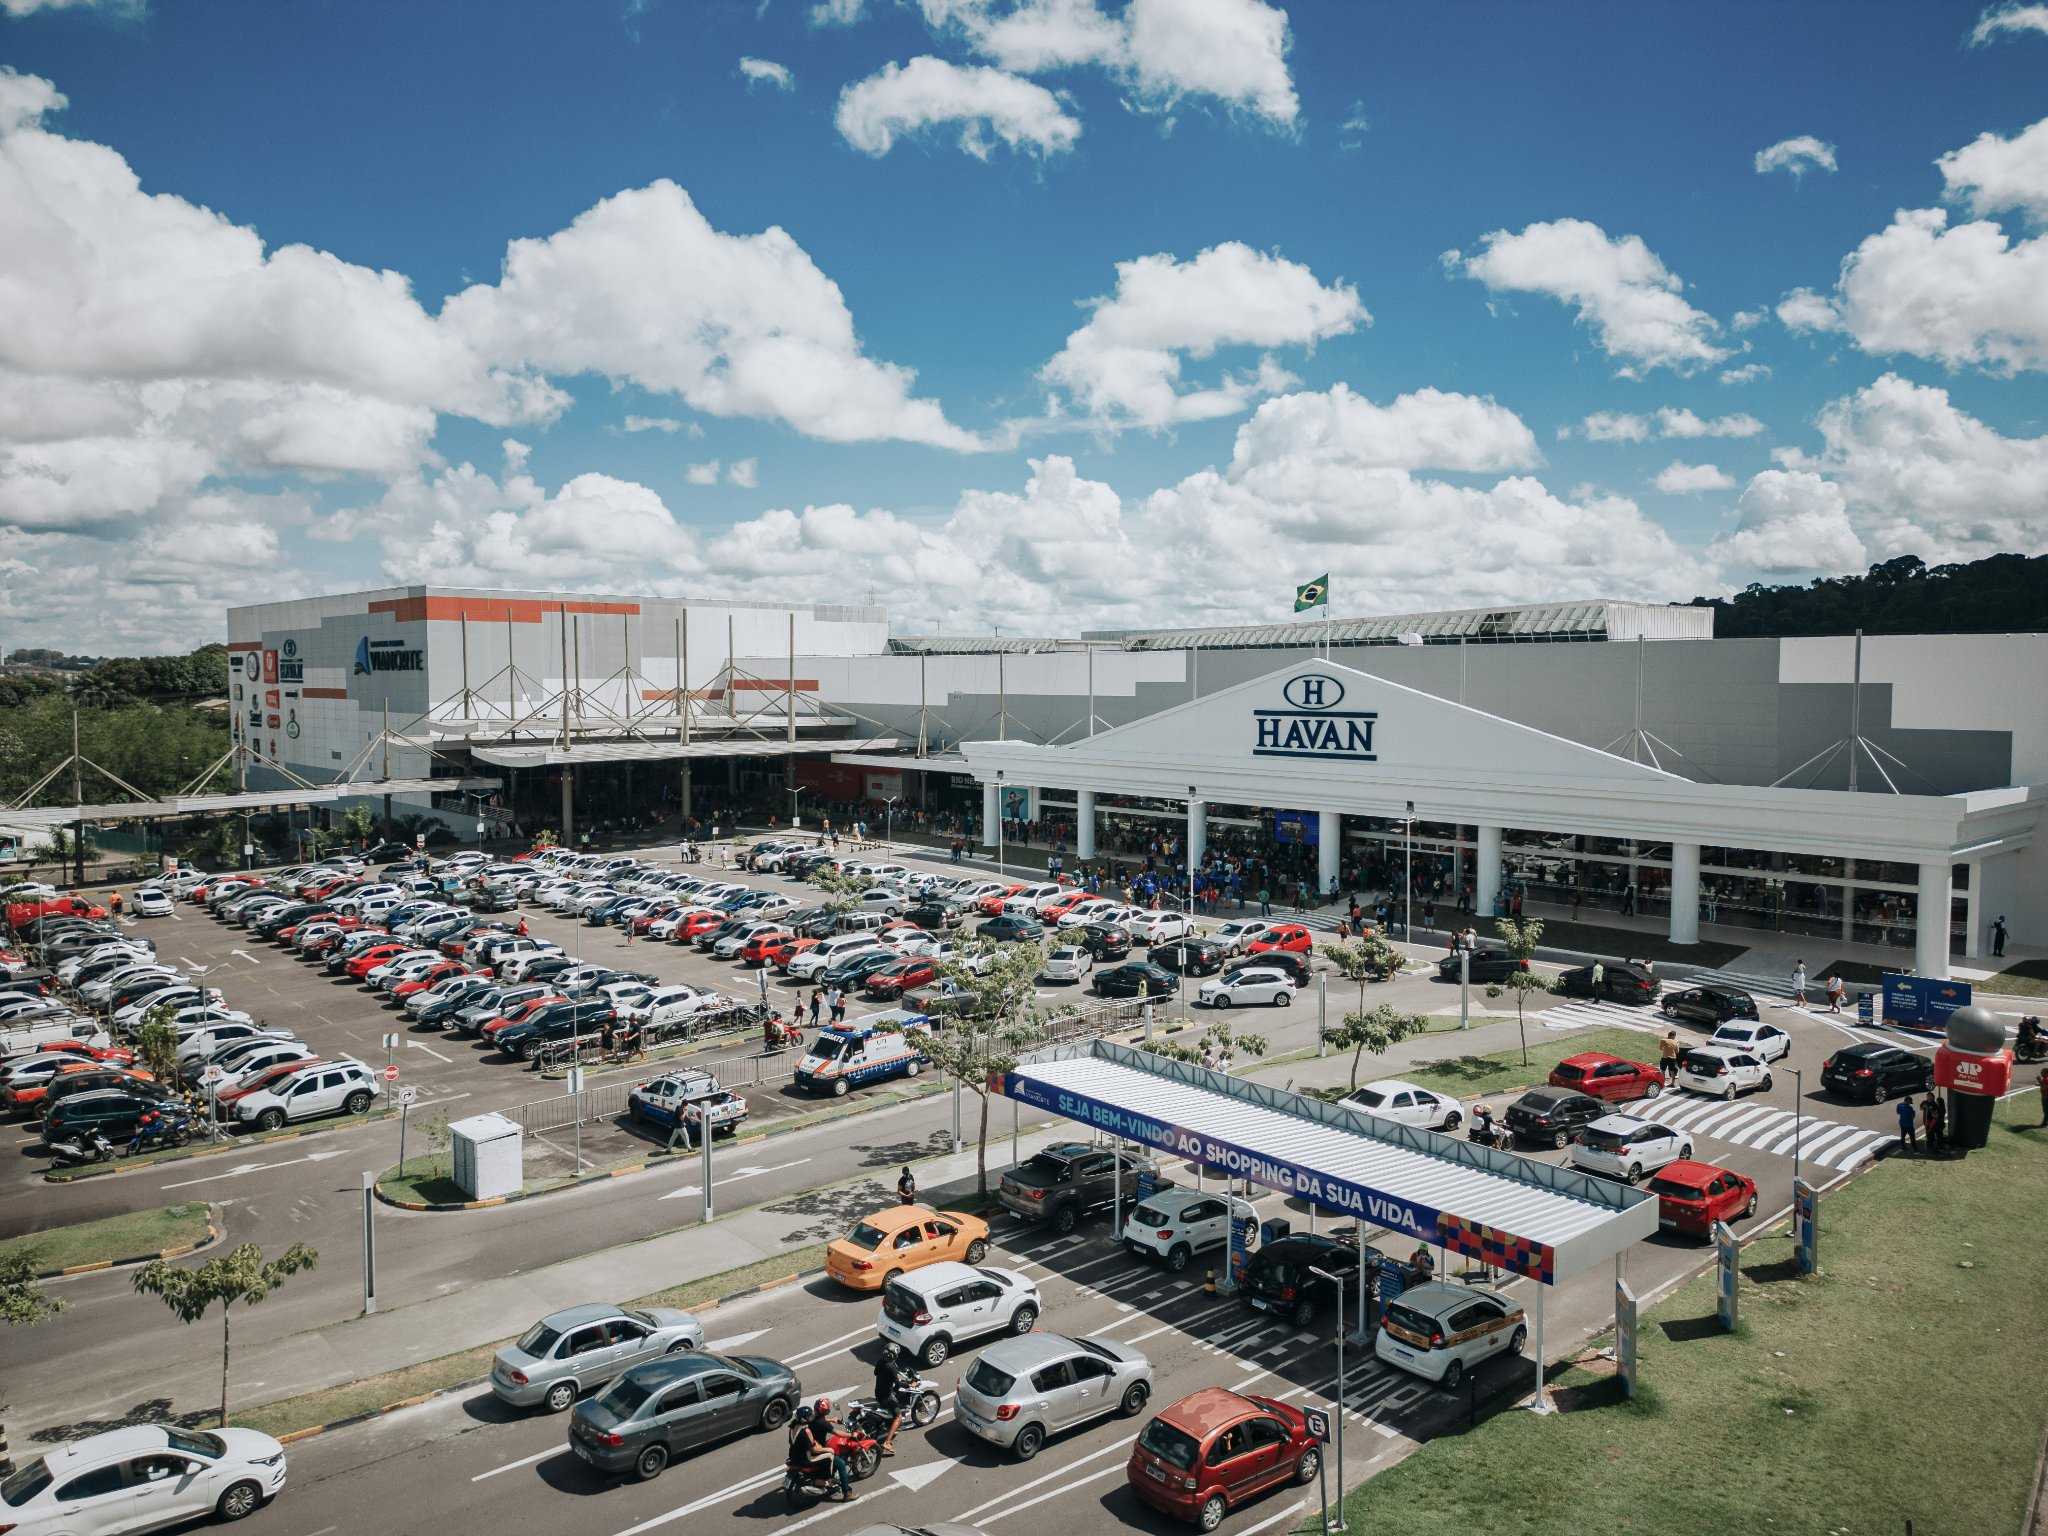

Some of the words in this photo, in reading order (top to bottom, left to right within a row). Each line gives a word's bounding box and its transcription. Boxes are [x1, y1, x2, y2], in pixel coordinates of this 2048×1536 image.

[1302, 680, 1325, 704] H
[1256, 718, 1375, 751] HAVAN
[1058, 1094, 1090, 1119] SEJA
[1092, 1105, 1175, 1147] BEM-VINDO
[1178, 1134, 1201, 1156] AO
[1206, 1143, 1293, 1187] SHOPPING
[1296, 1172, 1322, 1199] DA
[1326, 1183, 1364, 1212] SUA
[1367, 1195, 1423, 1232] VIDA.
